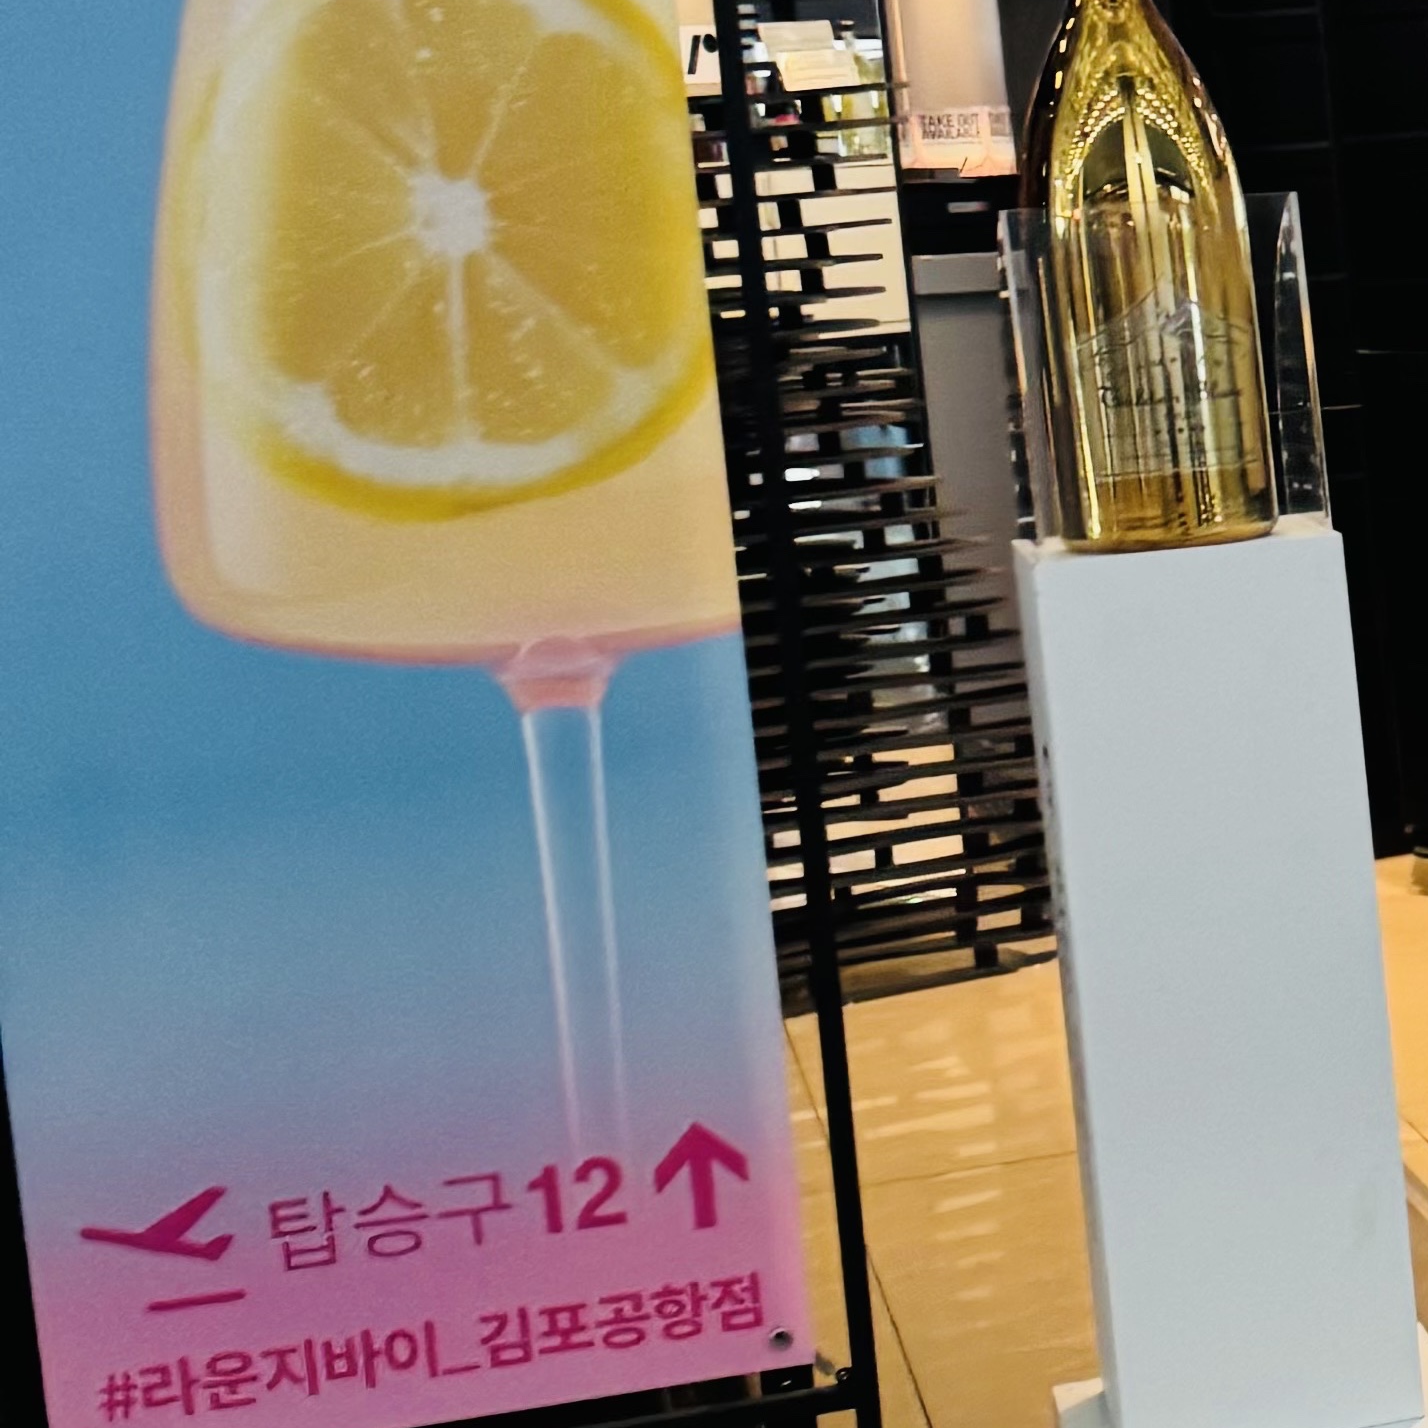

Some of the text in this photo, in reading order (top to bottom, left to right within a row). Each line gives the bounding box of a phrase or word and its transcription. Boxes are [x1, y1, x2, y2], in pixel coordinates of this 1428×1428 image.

[269, 1156, 628, 1272] 탑승구 12
[98, 1270, 765, 1422] #라운지바이_김포공항점
